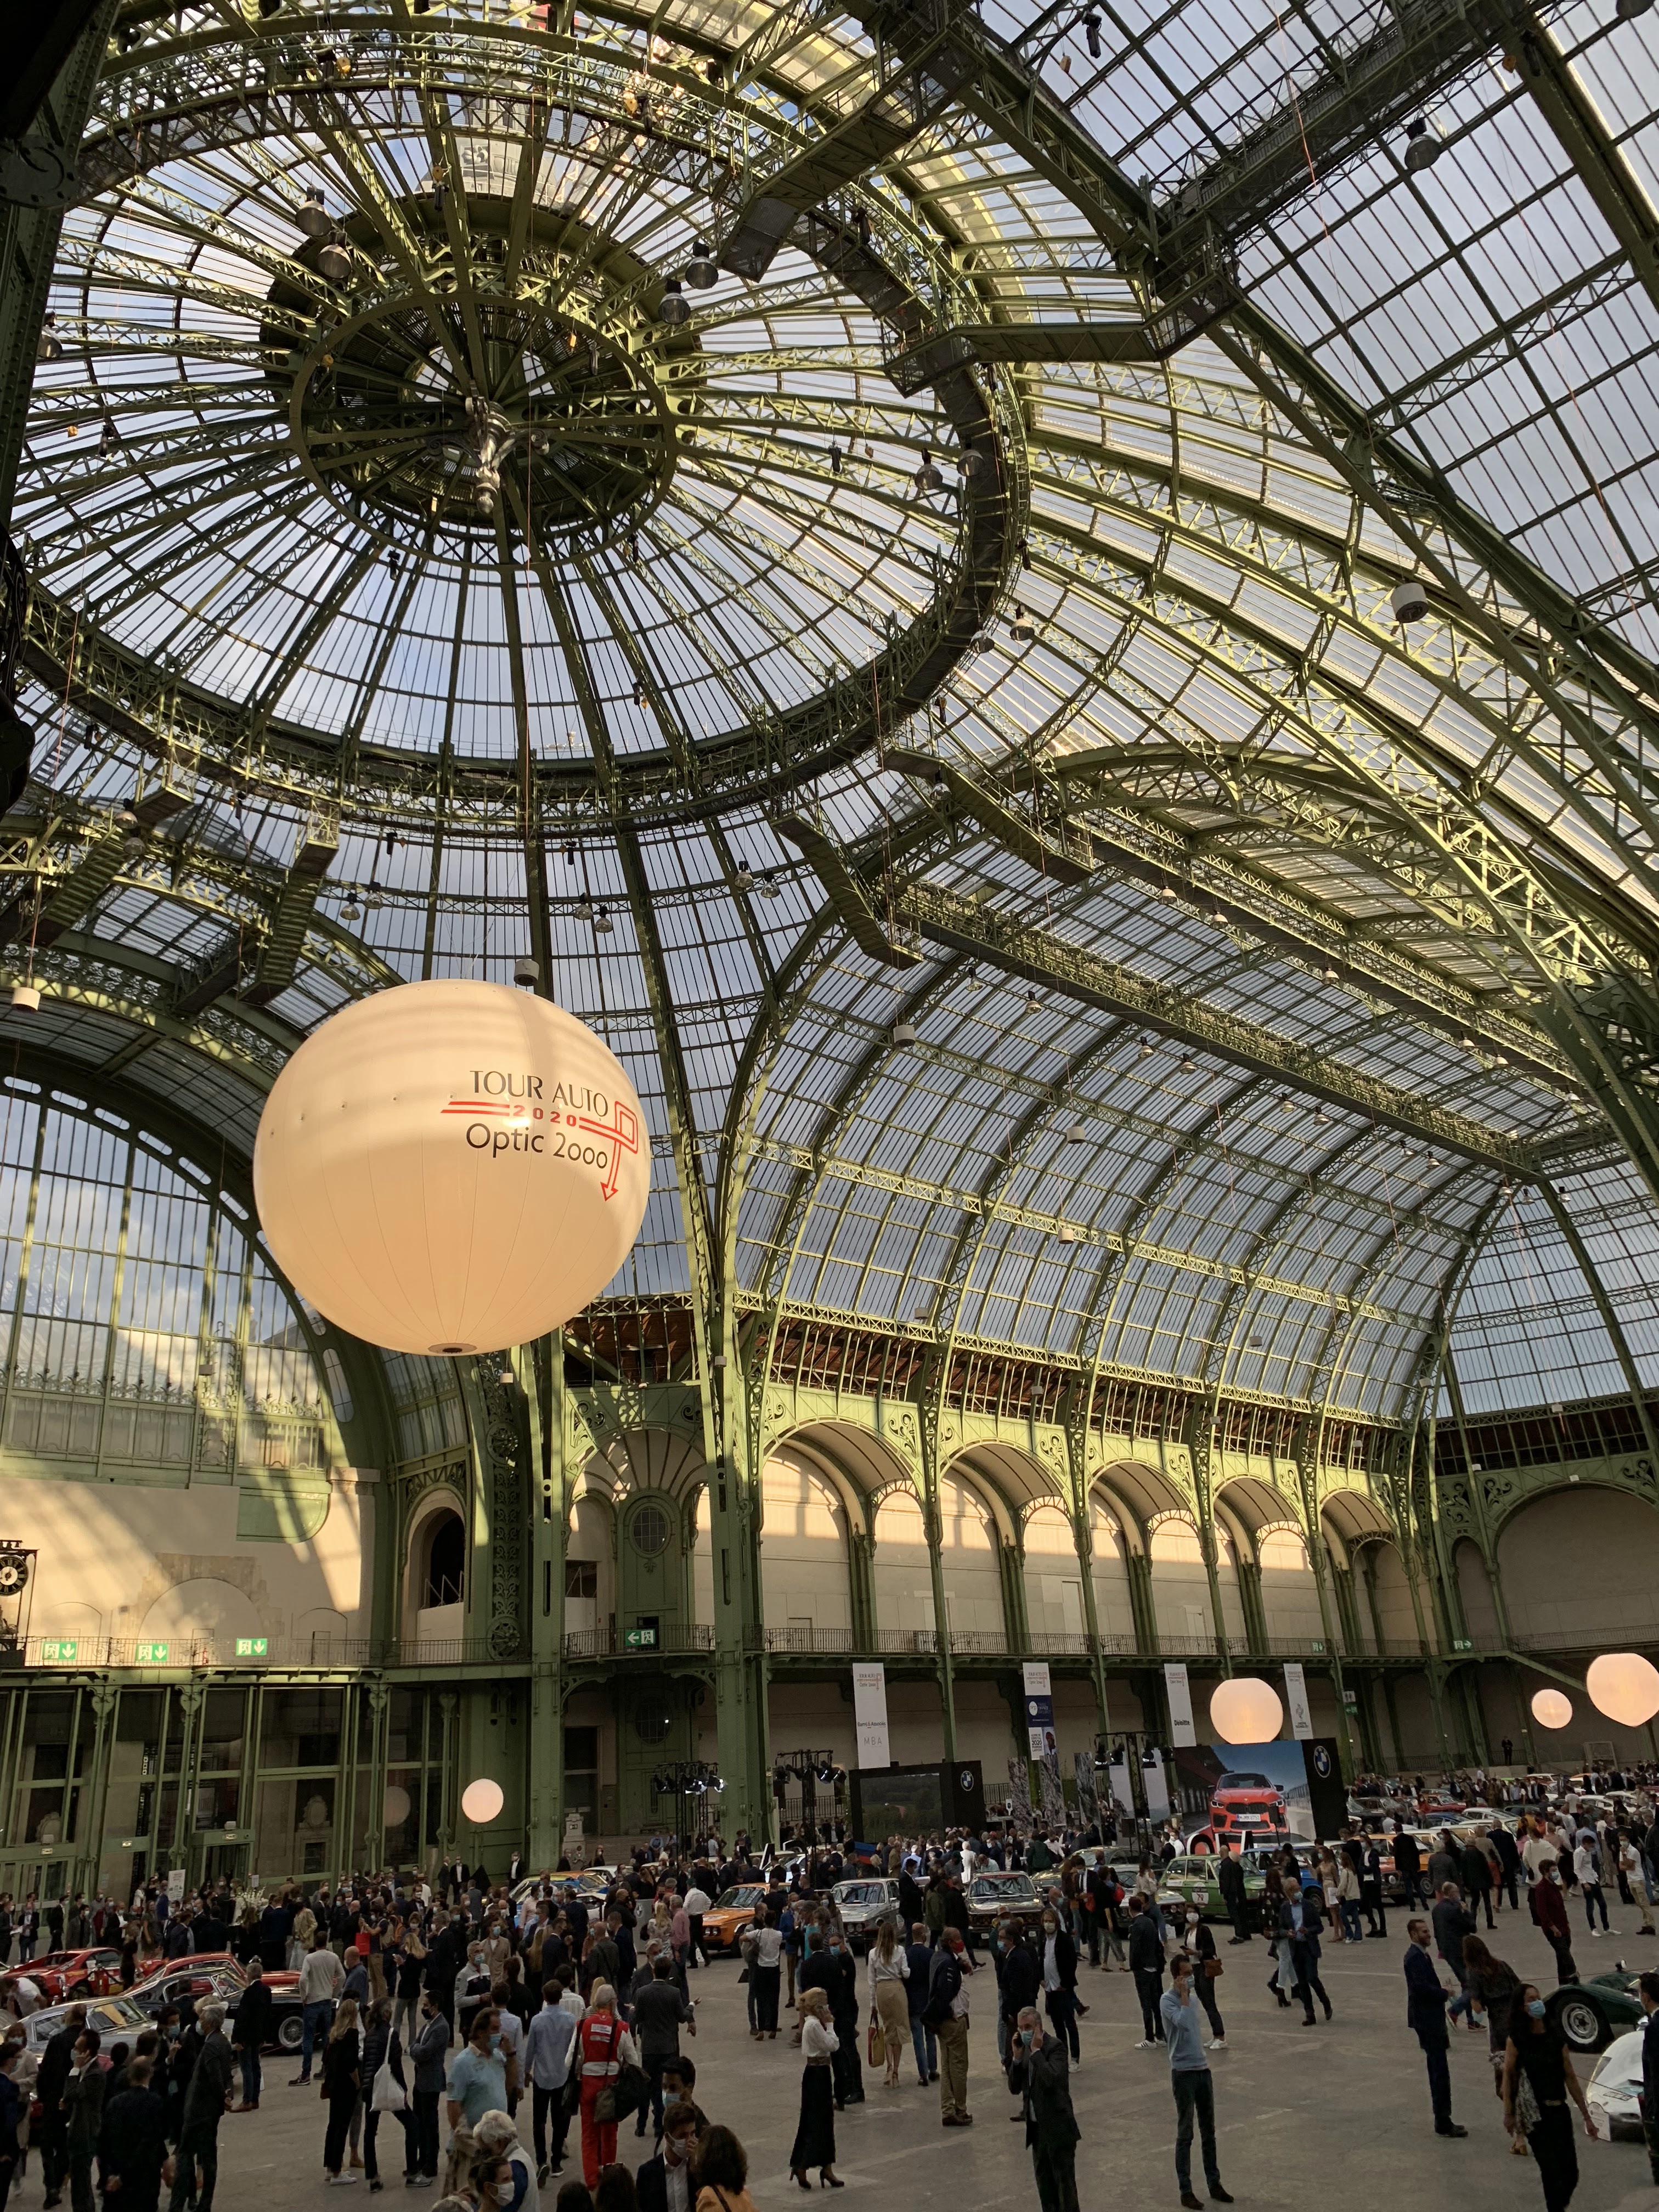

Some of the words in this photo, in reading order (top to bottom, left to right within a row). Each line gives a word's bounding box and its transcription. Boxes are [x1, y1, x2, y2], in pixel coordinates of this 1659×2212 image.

[470, 1070, 543, 1100] TOUR
[552, 1082, 608, 1117] AUTO
[513, 1105, 577, 1127] 2020
[466, 1123, 544, 1158] Optic
[552, 1132, 608, 1169] 2000
